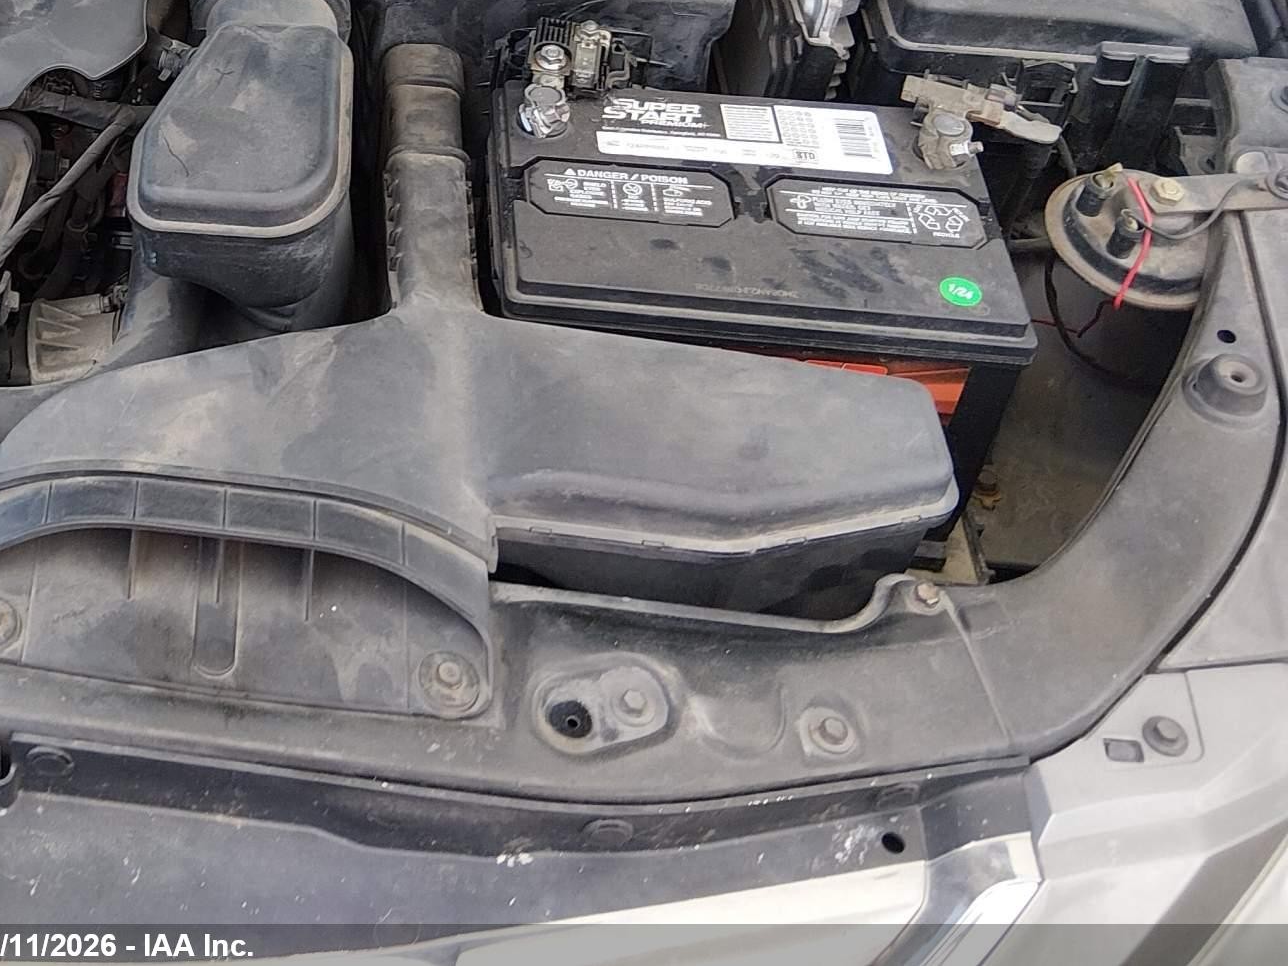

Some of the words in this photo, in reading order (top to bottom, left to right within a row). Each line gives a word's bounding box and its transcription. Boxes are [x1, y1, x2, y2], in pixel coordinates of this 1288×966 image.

[601, 106, 703, 123] START
[612, 98, 702, 114] SUPER
[576, 168, 629, 181] DANGER
[640, 174, 688, 185] POISON
